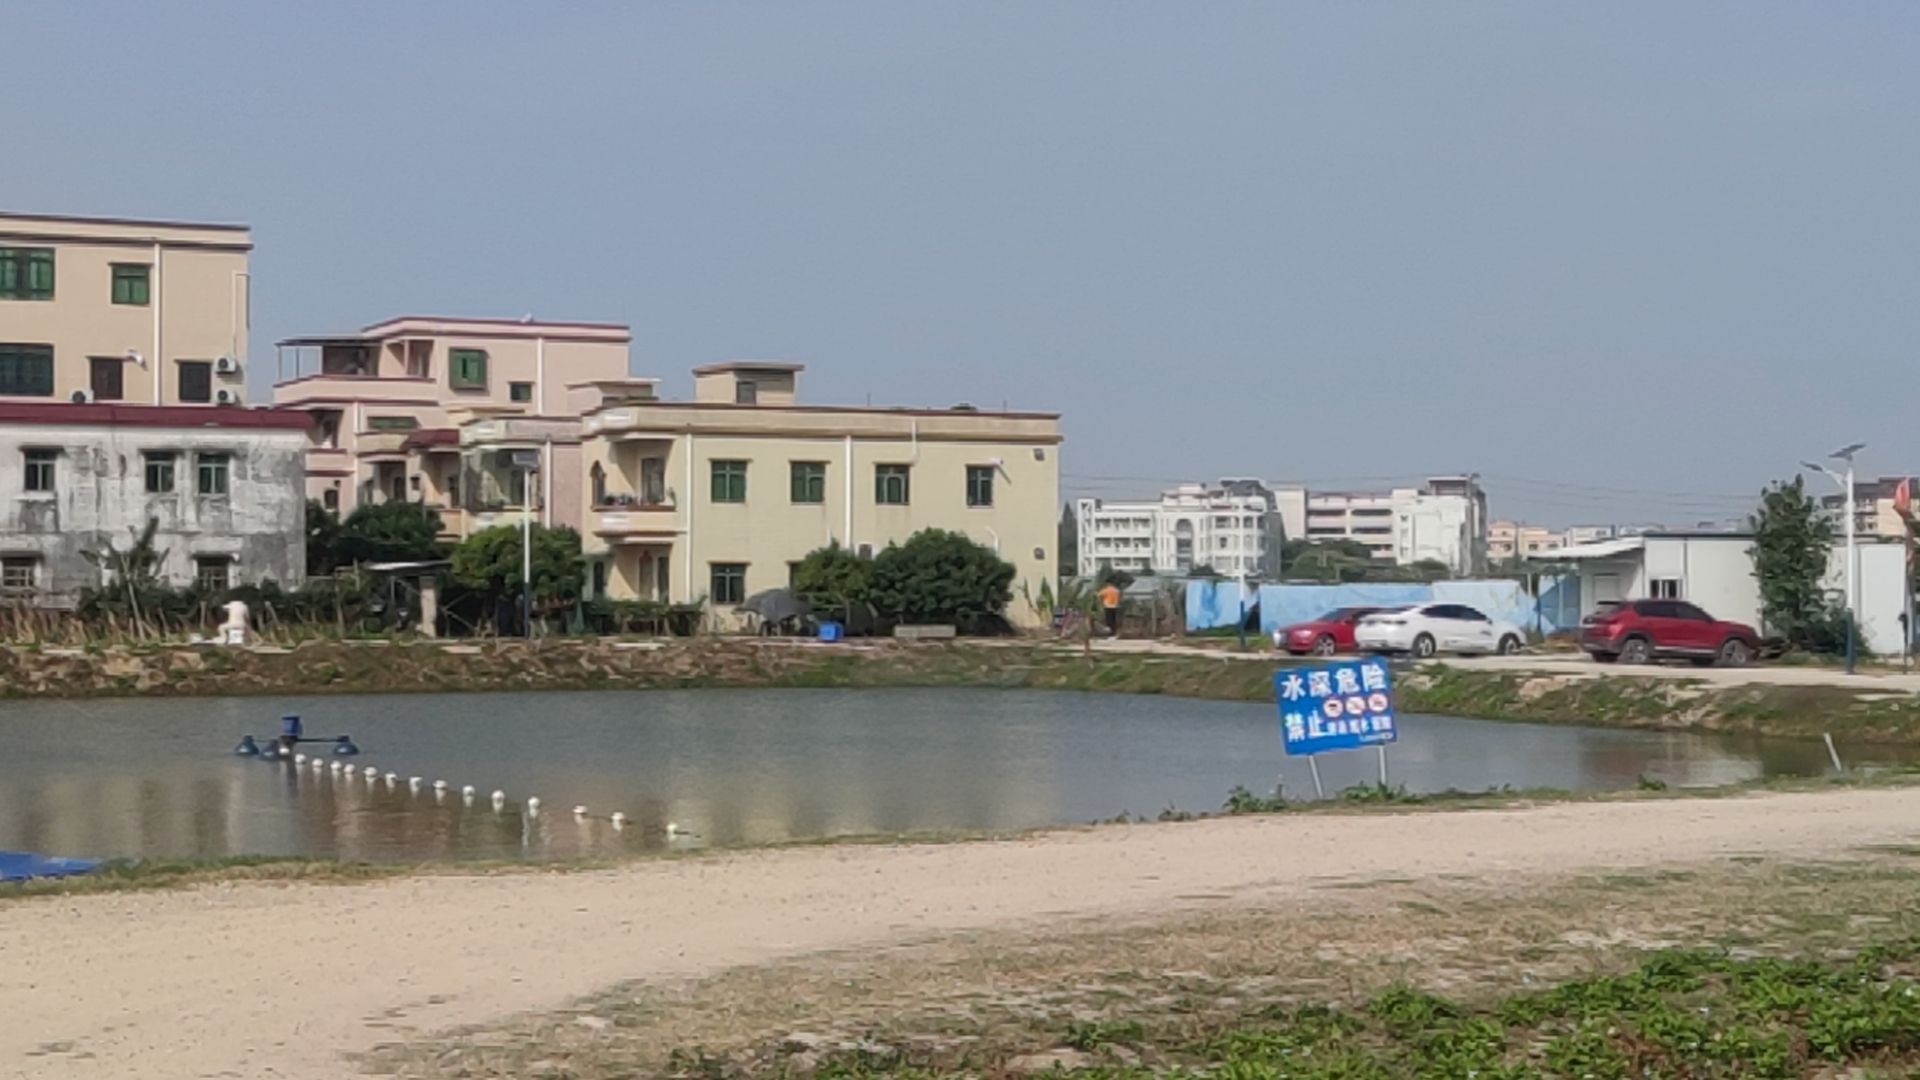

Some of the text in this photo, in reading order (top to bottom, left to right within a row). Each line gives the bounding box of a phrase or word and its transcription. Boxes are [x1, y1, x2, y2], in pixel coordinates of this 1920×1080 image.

[1281, 663, 1387, 701] 水深危险
[1285, 709, 1331, 742] 禁止
